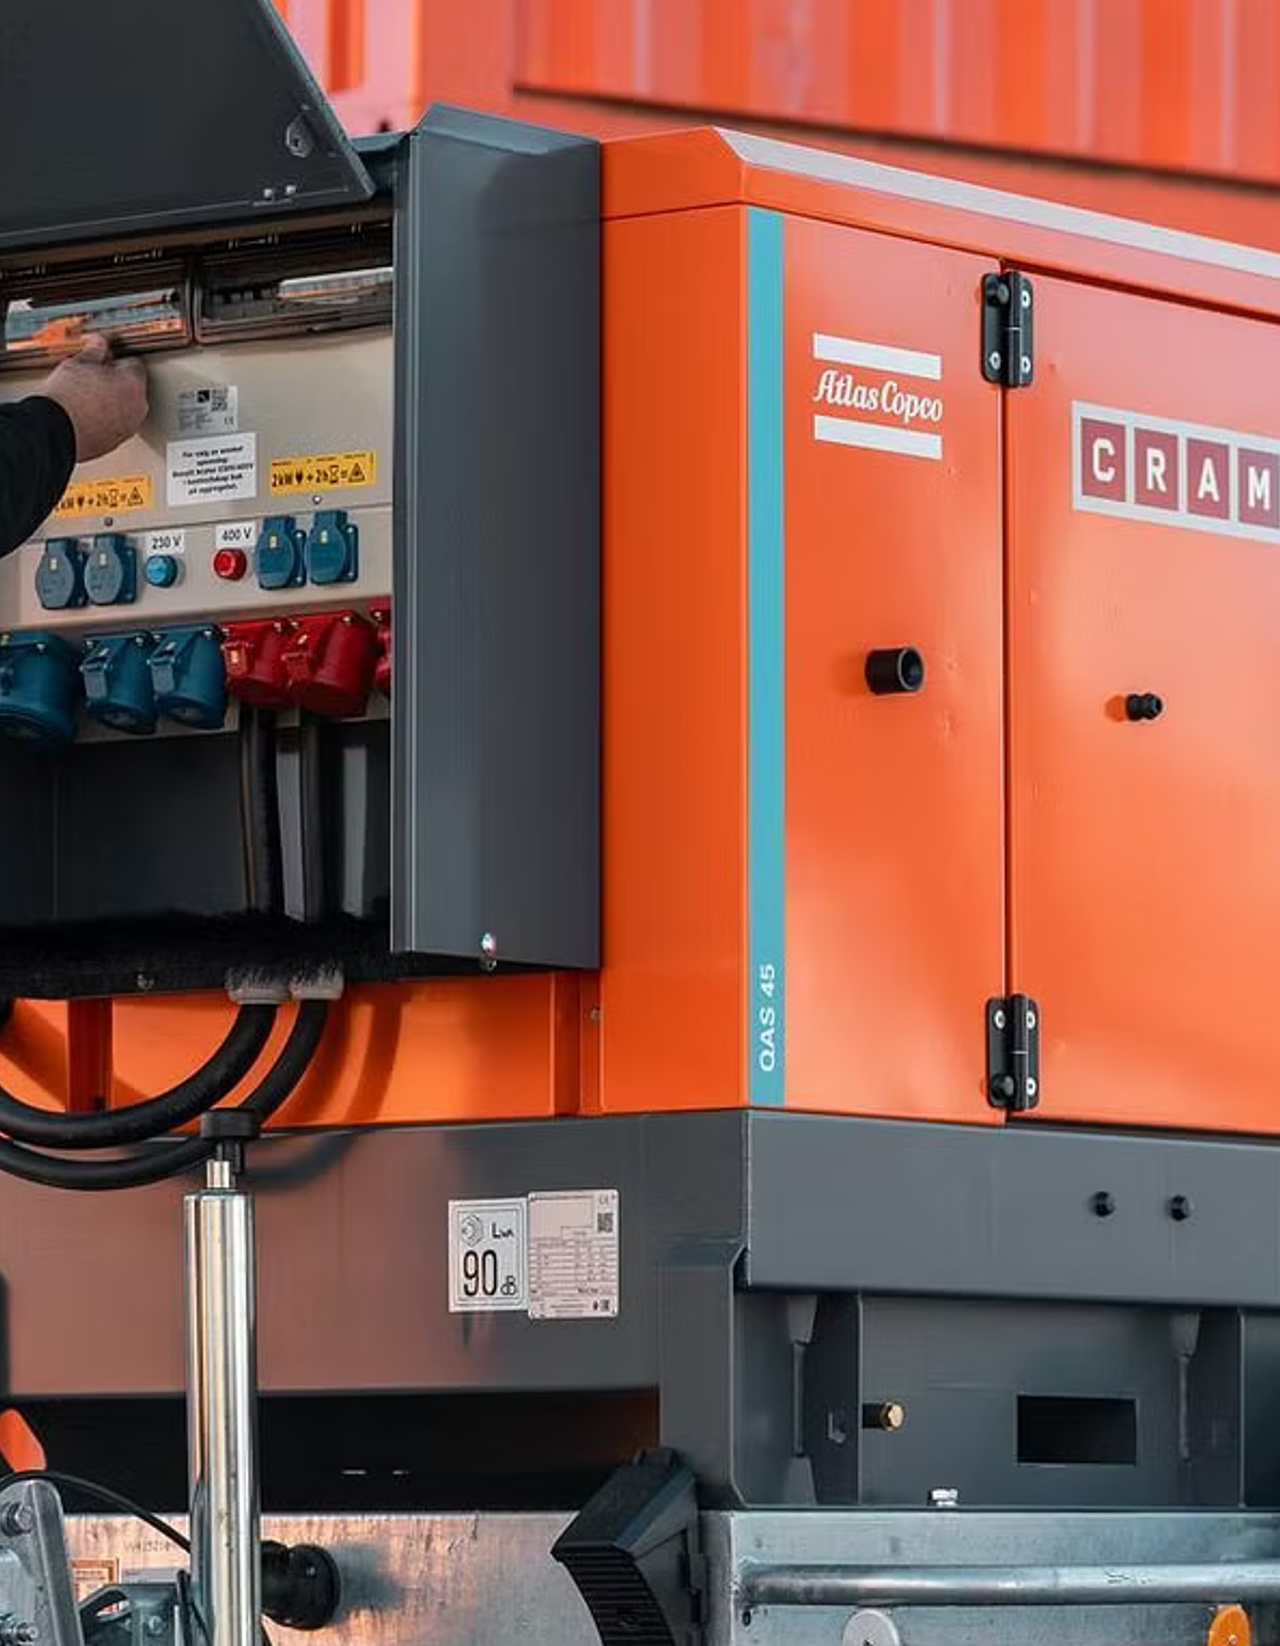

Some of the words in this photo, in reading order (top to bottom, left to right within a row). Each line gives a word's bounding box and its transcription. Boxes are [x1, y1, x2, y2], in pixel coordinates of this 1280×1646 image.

[813, 369, 879, 411] Atlas
[880, 380, 943, 424] Copco
[272, 473, 293, 488] 2kW
[152, 535, 171, 550] 230
[173, 534, 182, 547] V
[222, 529, 241, 541] 400
[243, 527, 252, 539] V
[759, 964, 776, 997] 45
[759, 1007, 776, 1072] QAS
[463, 1249, 498, 1297] 90
